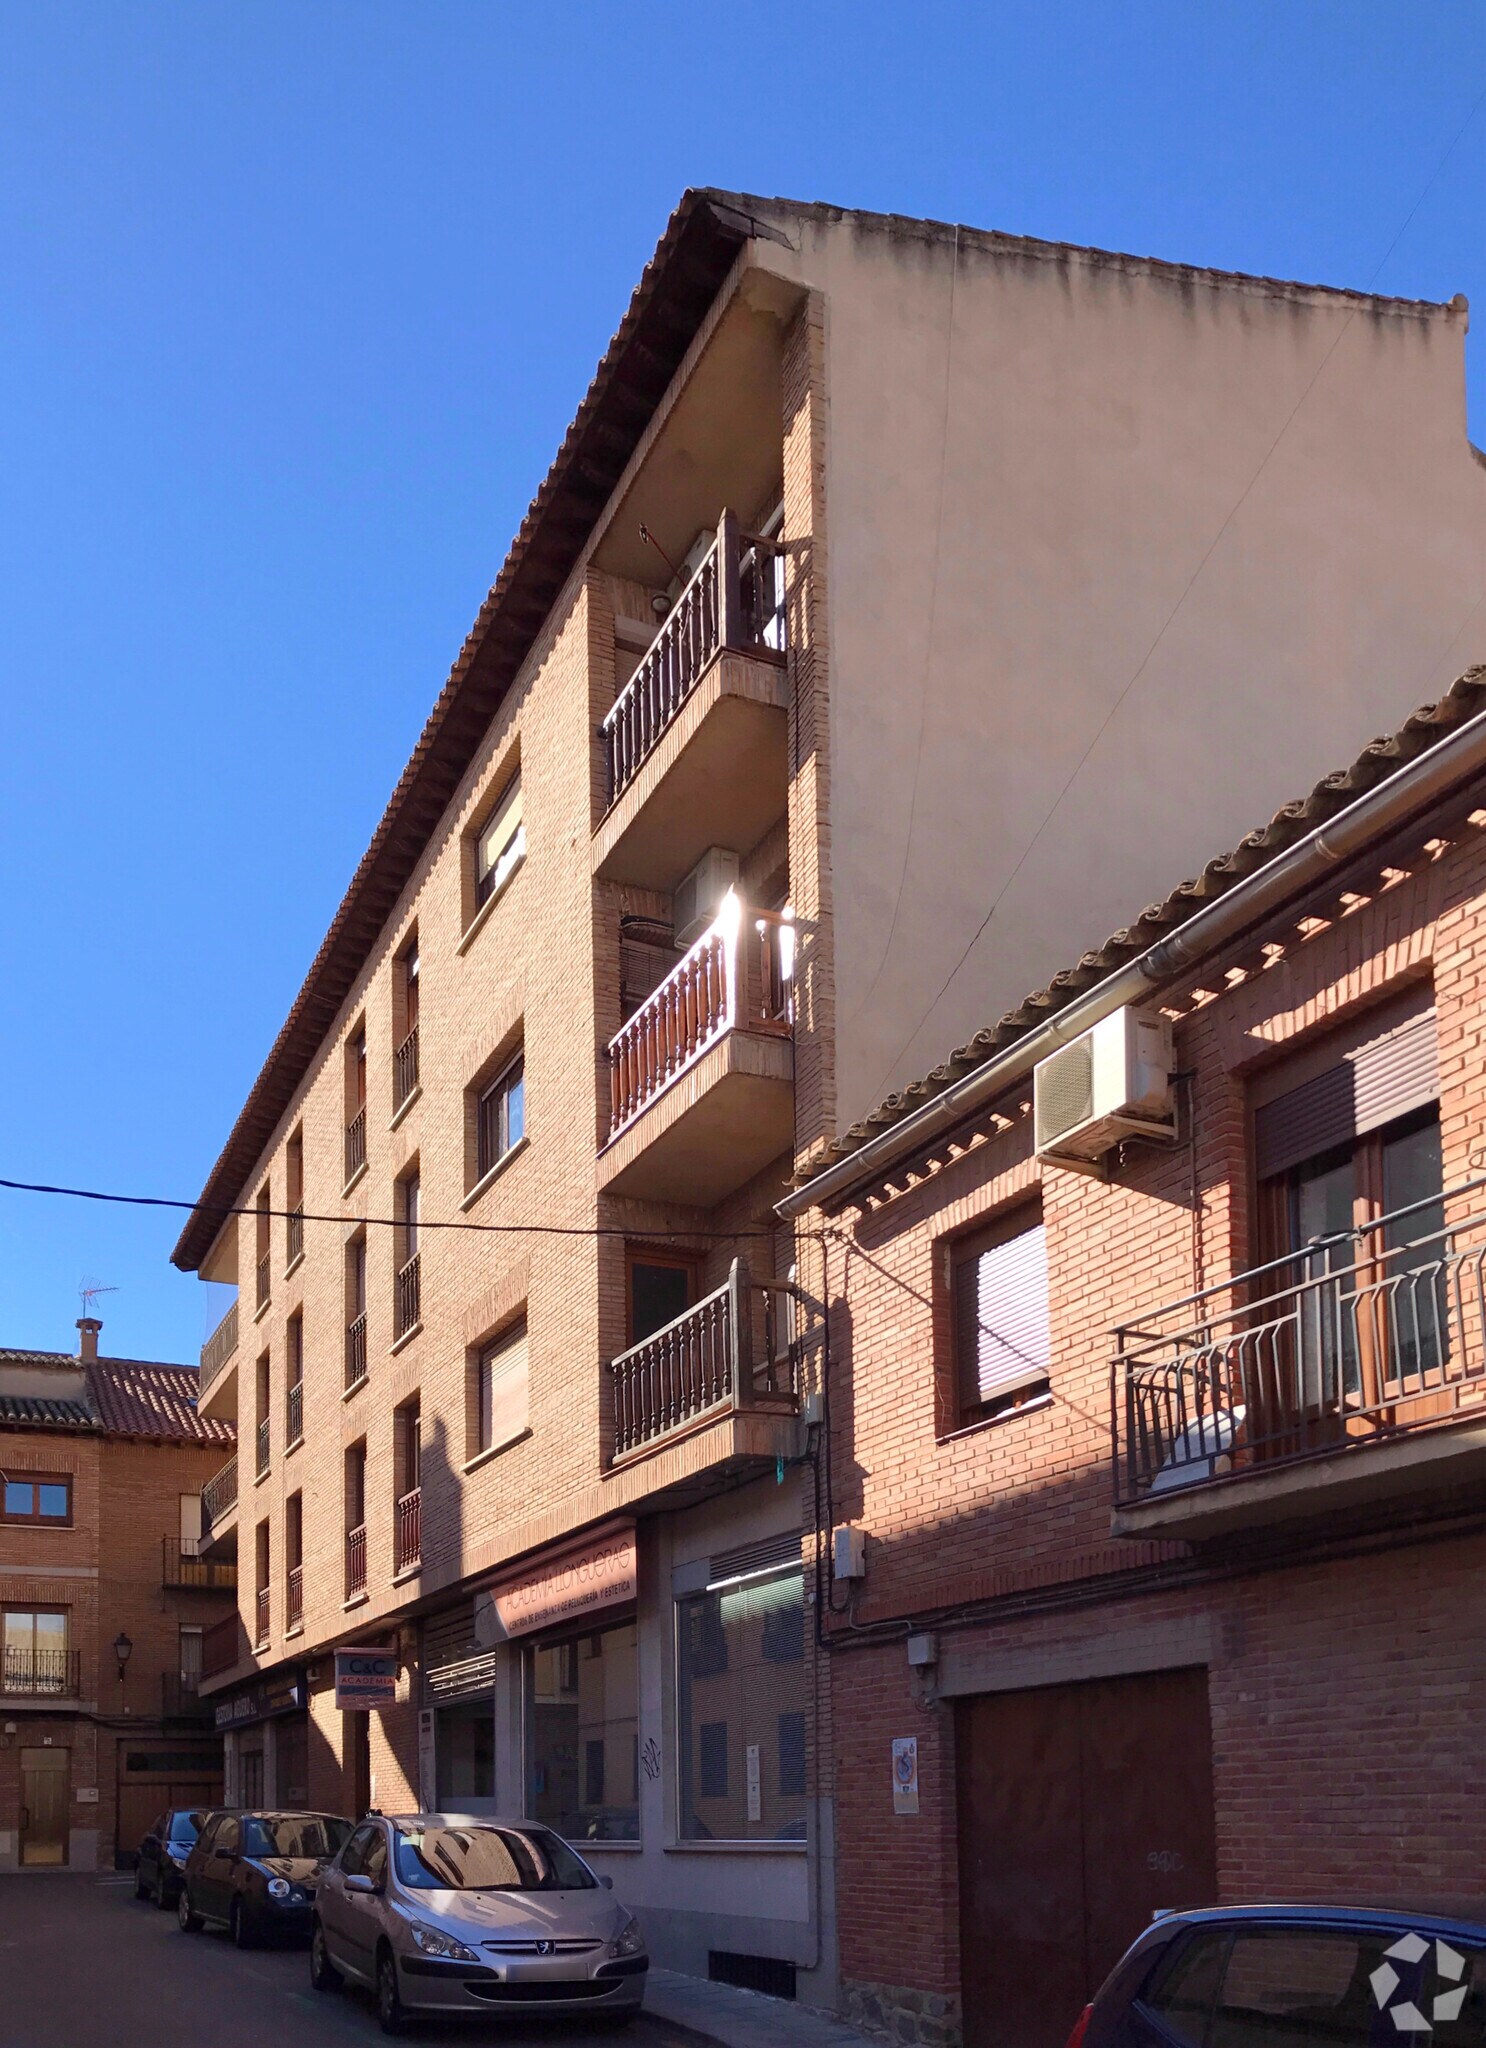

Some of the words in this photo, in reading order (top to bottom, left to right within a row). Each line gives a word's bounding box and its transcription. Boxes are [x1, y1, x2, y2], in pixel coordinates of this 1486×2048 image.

[506, 1573, 553, 1611] ACADEMIA
[556, 1541, 631, 1593] LLONGUERAS
[600, 1588, 605, 1599] Y
[350, 1659, 385, 1674] C&C
[341, 1677, 394, 1685] ACADEMIA
